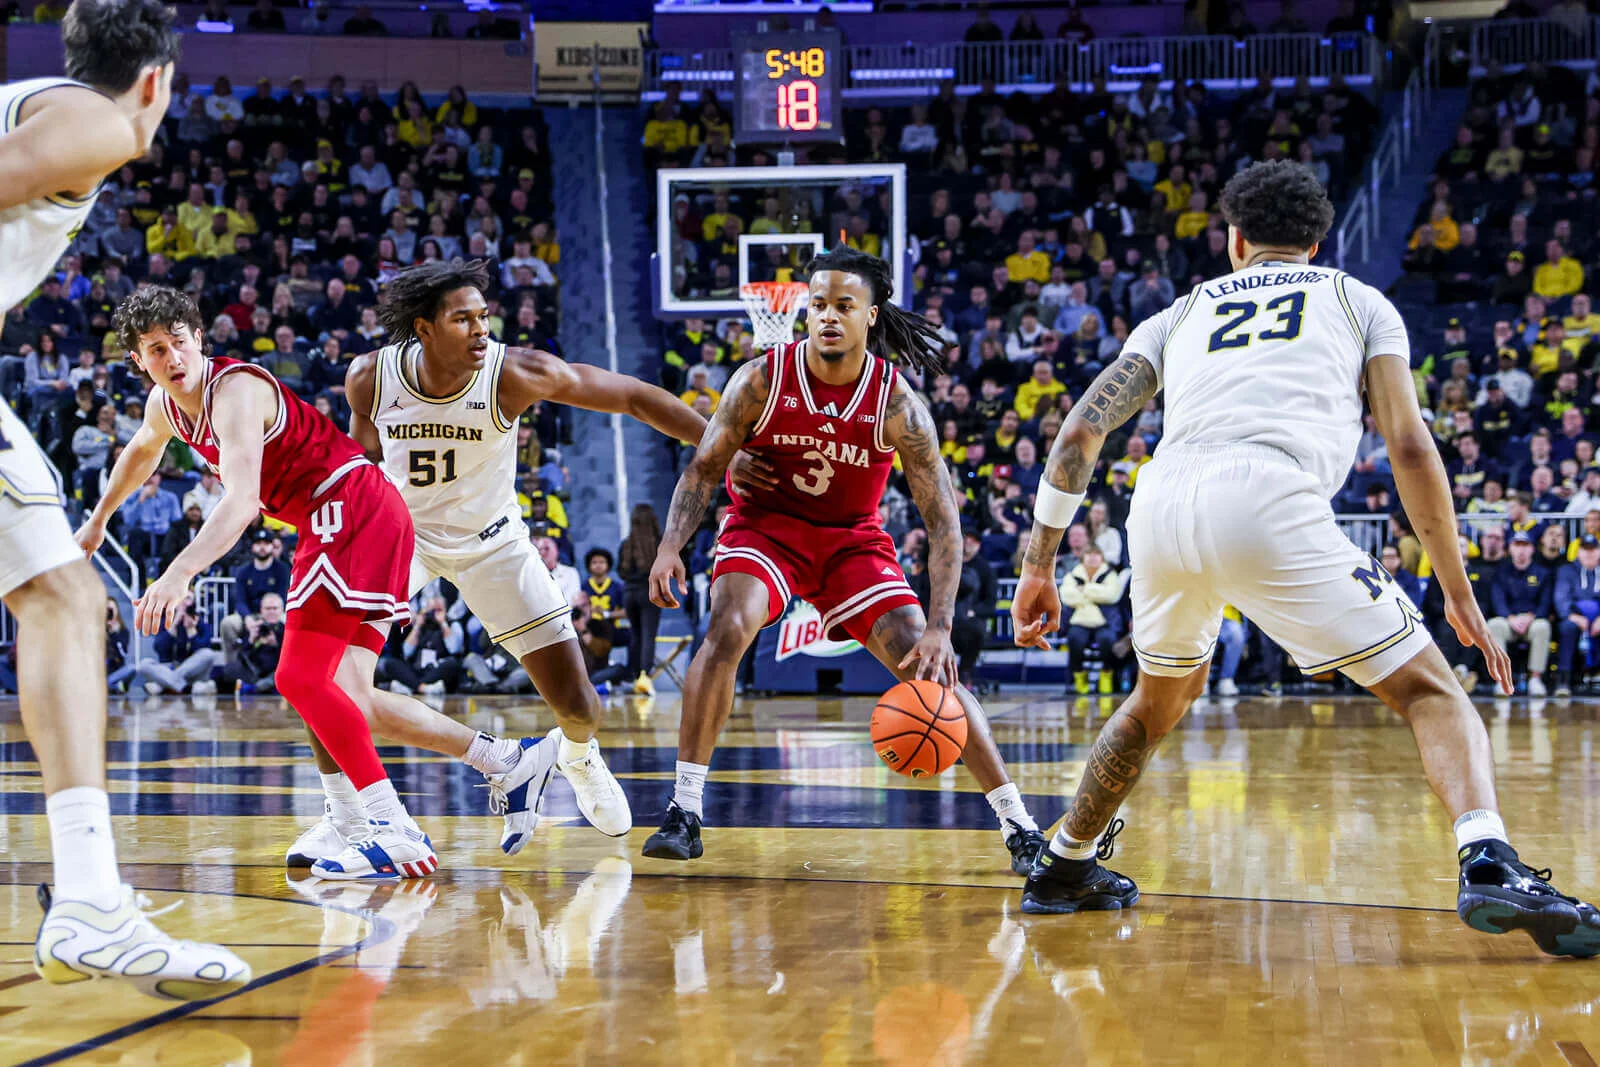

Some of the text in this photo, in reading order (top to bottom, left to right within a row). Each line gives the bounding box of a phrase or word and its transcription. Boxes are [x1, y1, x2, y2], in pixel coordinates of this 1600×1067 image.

[766, 48, 825, 78] 5:48
[777, 80, 818, 131] 18
[1205, 271, 1329, 299] LENDEBORG
[1207, 291, 1307, 353] 23
[783, 396, 798, 408] 76
[387, 424, 483, 441] MICHIGAN
[409, 449, 458, 487] 51
[772, 434, 870, 468] INDIANA
[792, 450, 835, 496] 3
[1351, 556, 1393, 601] M
[781, 621, 825, 655] LIB
